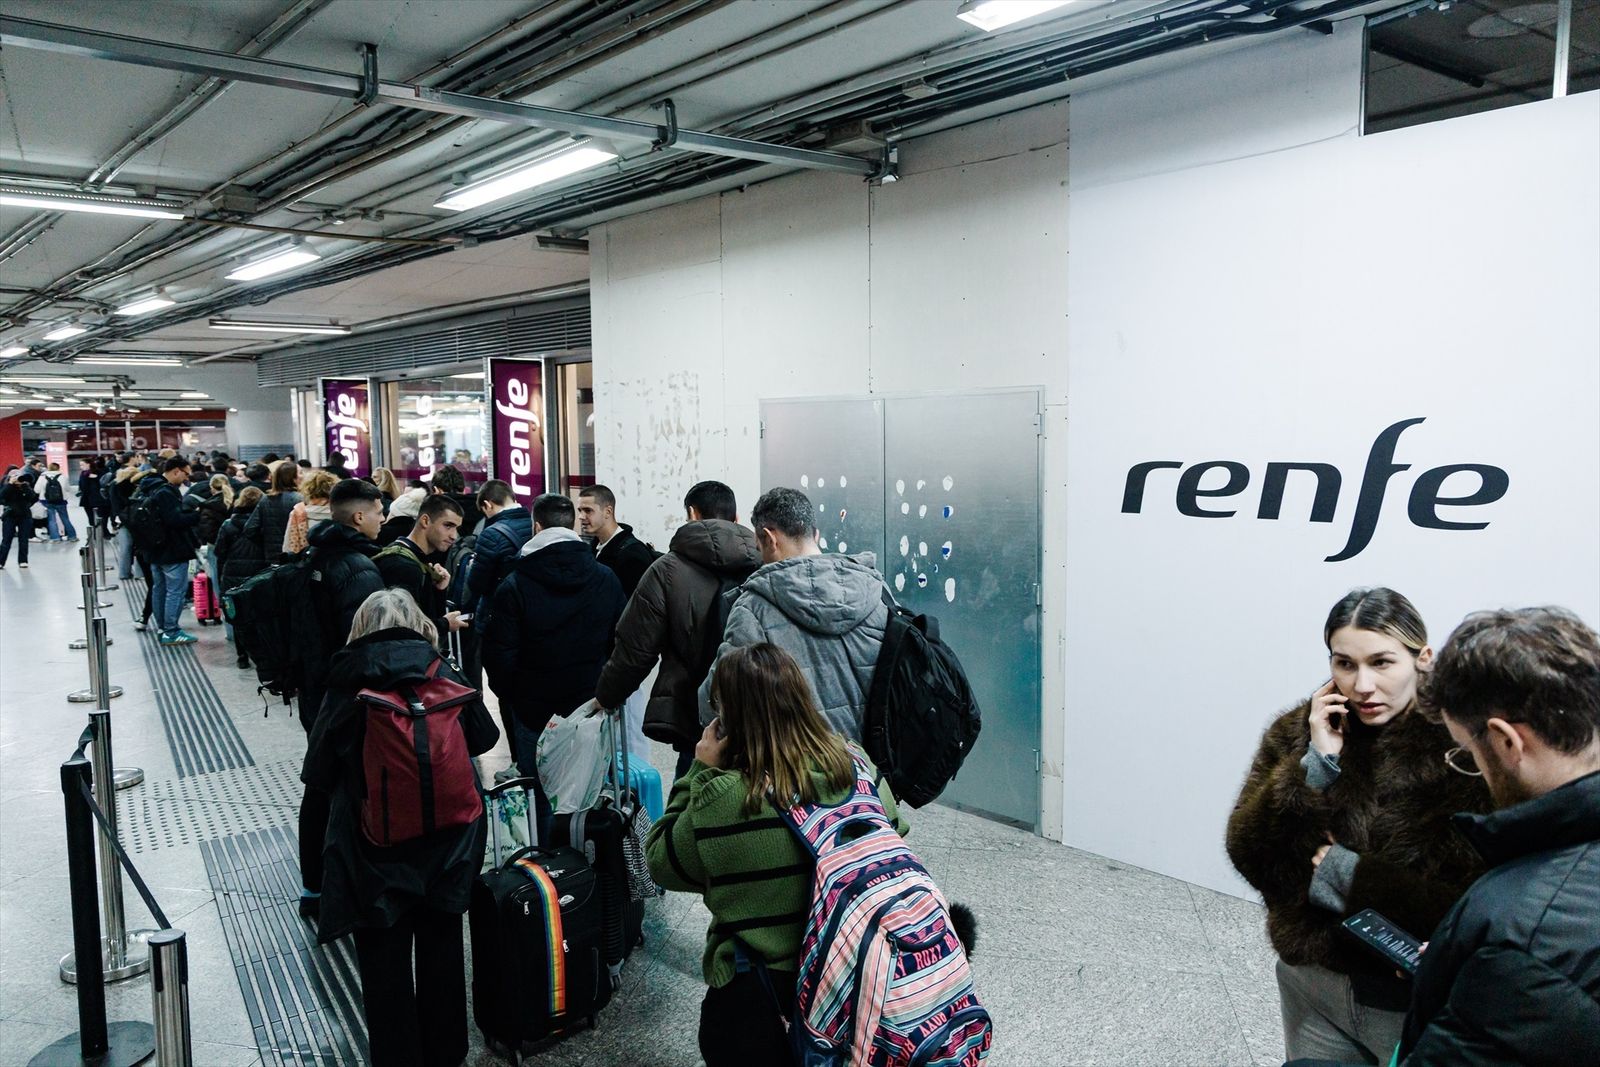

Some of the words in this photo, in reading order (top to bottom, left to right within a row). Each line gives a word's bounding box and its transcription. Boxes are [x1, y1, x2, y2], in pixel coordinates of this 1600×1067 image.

[328, 393, 368, 480] enfe
[496, 378, 540, 495] renfe
[1121, 417, 1510, 562] renfe
[912, 943, 943, 970] ROXY
